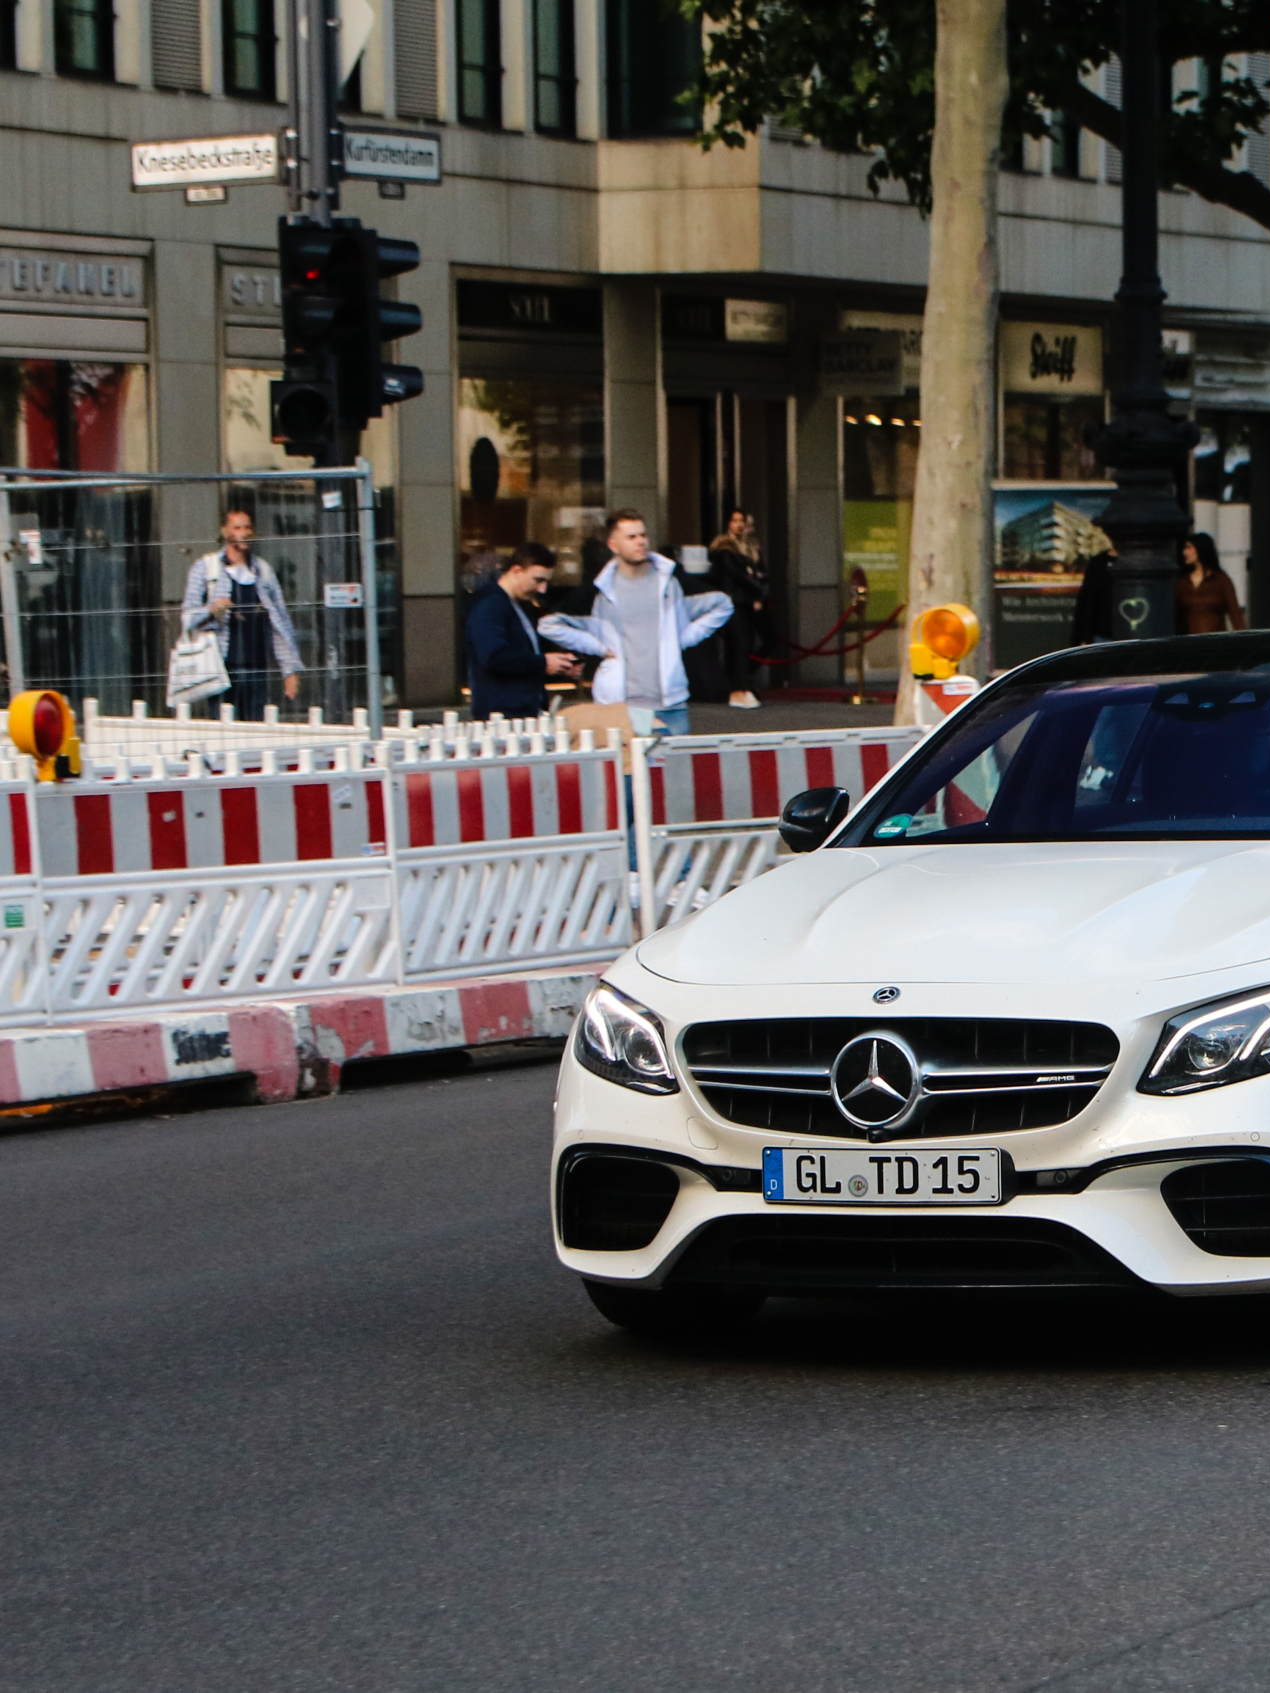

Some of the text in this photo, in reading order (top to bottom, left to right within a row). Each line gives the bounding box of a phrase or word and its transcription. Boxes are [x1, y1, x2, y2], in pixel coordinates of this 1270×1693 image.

[136, 143, 275, 174] Knesebeckstraße
[345, 138, 434, 168] Kurfürstendamm
[0, 257, 138, 299] EFANEL
[1029, 332, 1077, 383] Steiff
[770, 1179, 778, 1190] D
[796, 1155, 981, 1195] GL TD 15
